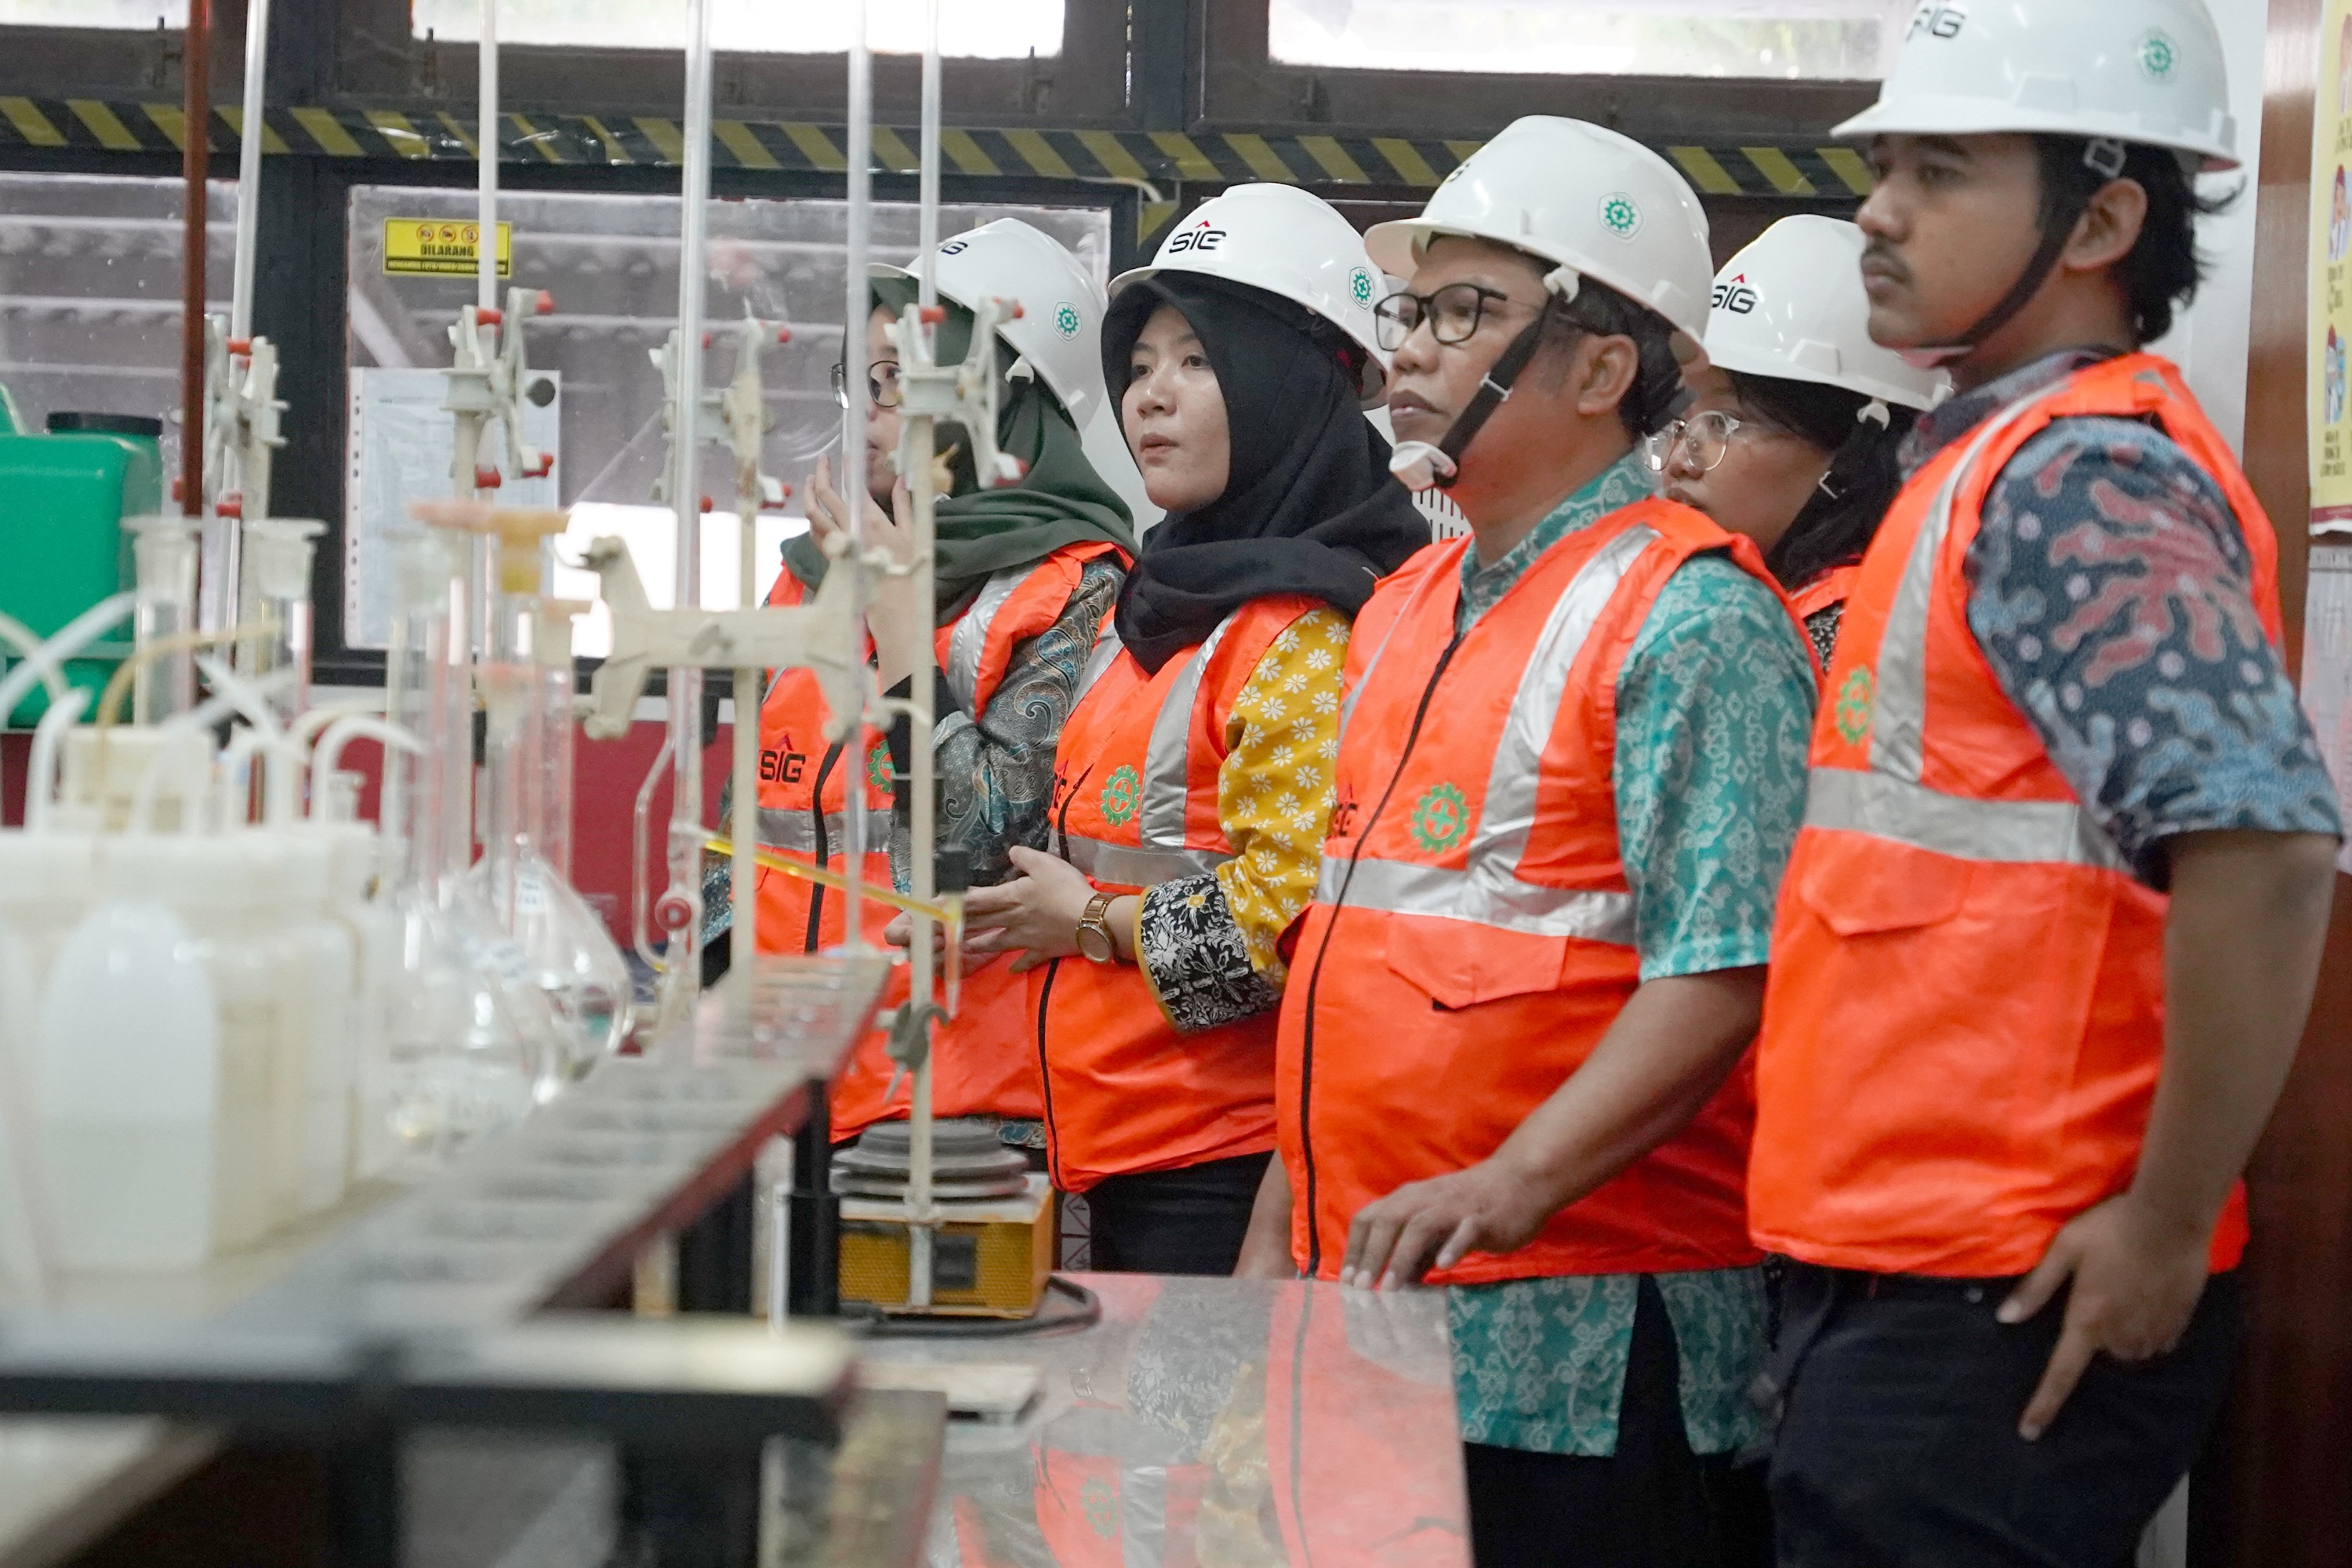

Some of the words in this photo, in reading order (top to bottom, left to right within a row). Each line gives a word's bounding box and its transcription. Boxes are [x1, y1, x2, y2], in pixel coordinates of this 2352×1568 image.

[420, 244, 474, 256] DILARANG
[1169, 230, 1227, 254] SIG
[1711, 285, 1758, 314] SIG
[760, 750, 806, 783] SIG
